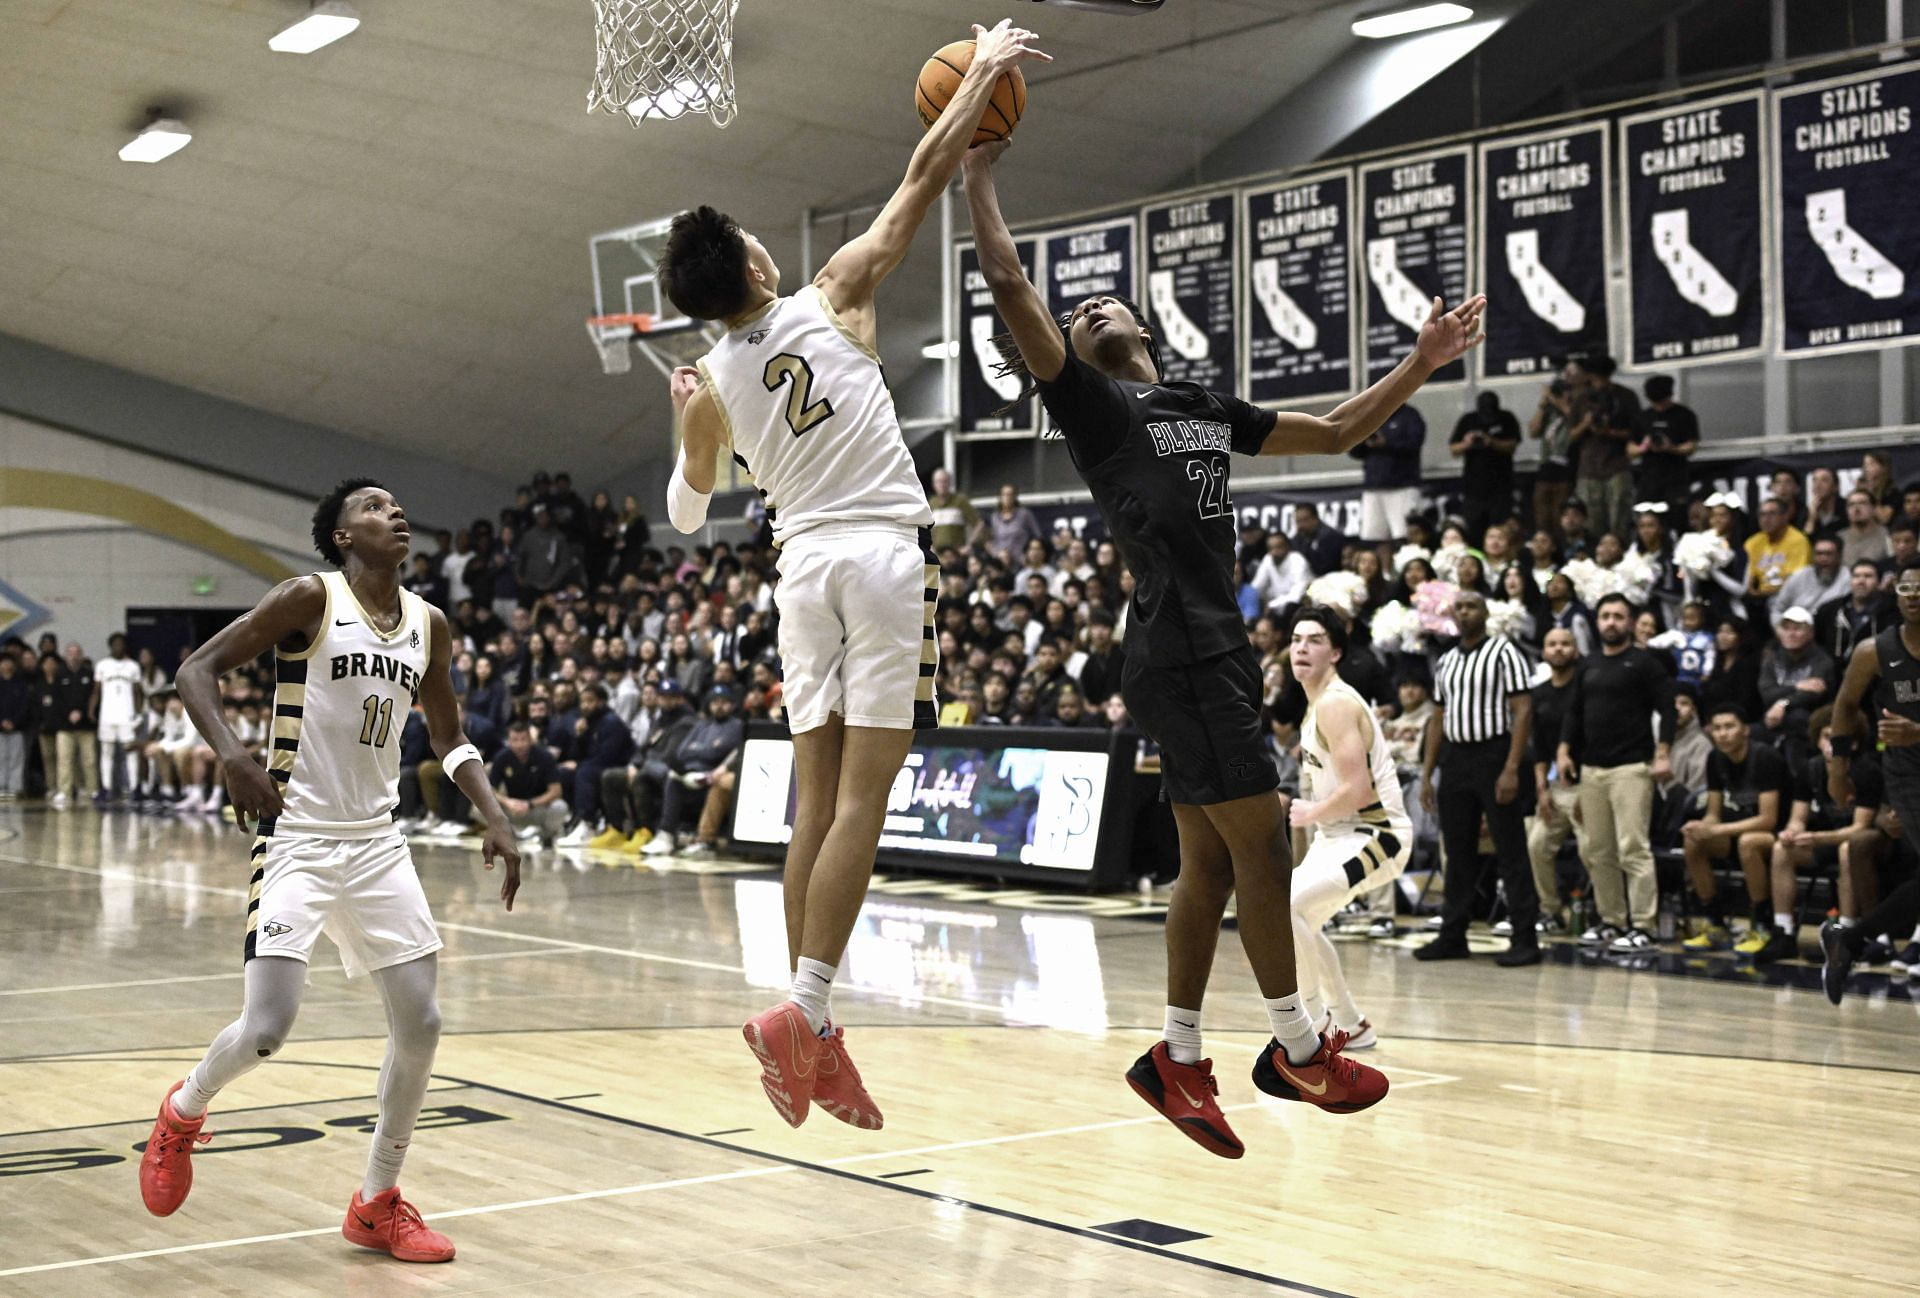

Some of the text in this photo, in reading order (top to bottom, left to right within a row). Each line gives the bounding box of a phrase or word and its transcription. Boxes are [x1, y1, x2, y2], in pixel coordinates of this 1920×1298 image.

[1821, 81, 1882, 117] STATE
[1662, 109, 1721, 144] STATE
[1795, 106, 1911, 151] CHAMPIONS
[1516, 139, 1570, 170] STATE
[1641, 133, 1745, 176] CHAMPIONS
[1815, 140, 1890, 171] FOOTBALL
[1392, 162, 1436, 190] STATE
[1496, 162, 1590, 200] CHAMPIONS
[1659, 165, 1726, 194] FOOTBALL
[1273, 185, 1320, 214] STATE
[1257, 205, 1339, 240] CHAMPIONS
[763, 352, 835, 438] 2
[1186, 456, 1233, 520] 22
[329, 652, 420, 698] BRAVES
[359, 694, 394, 748] 11
